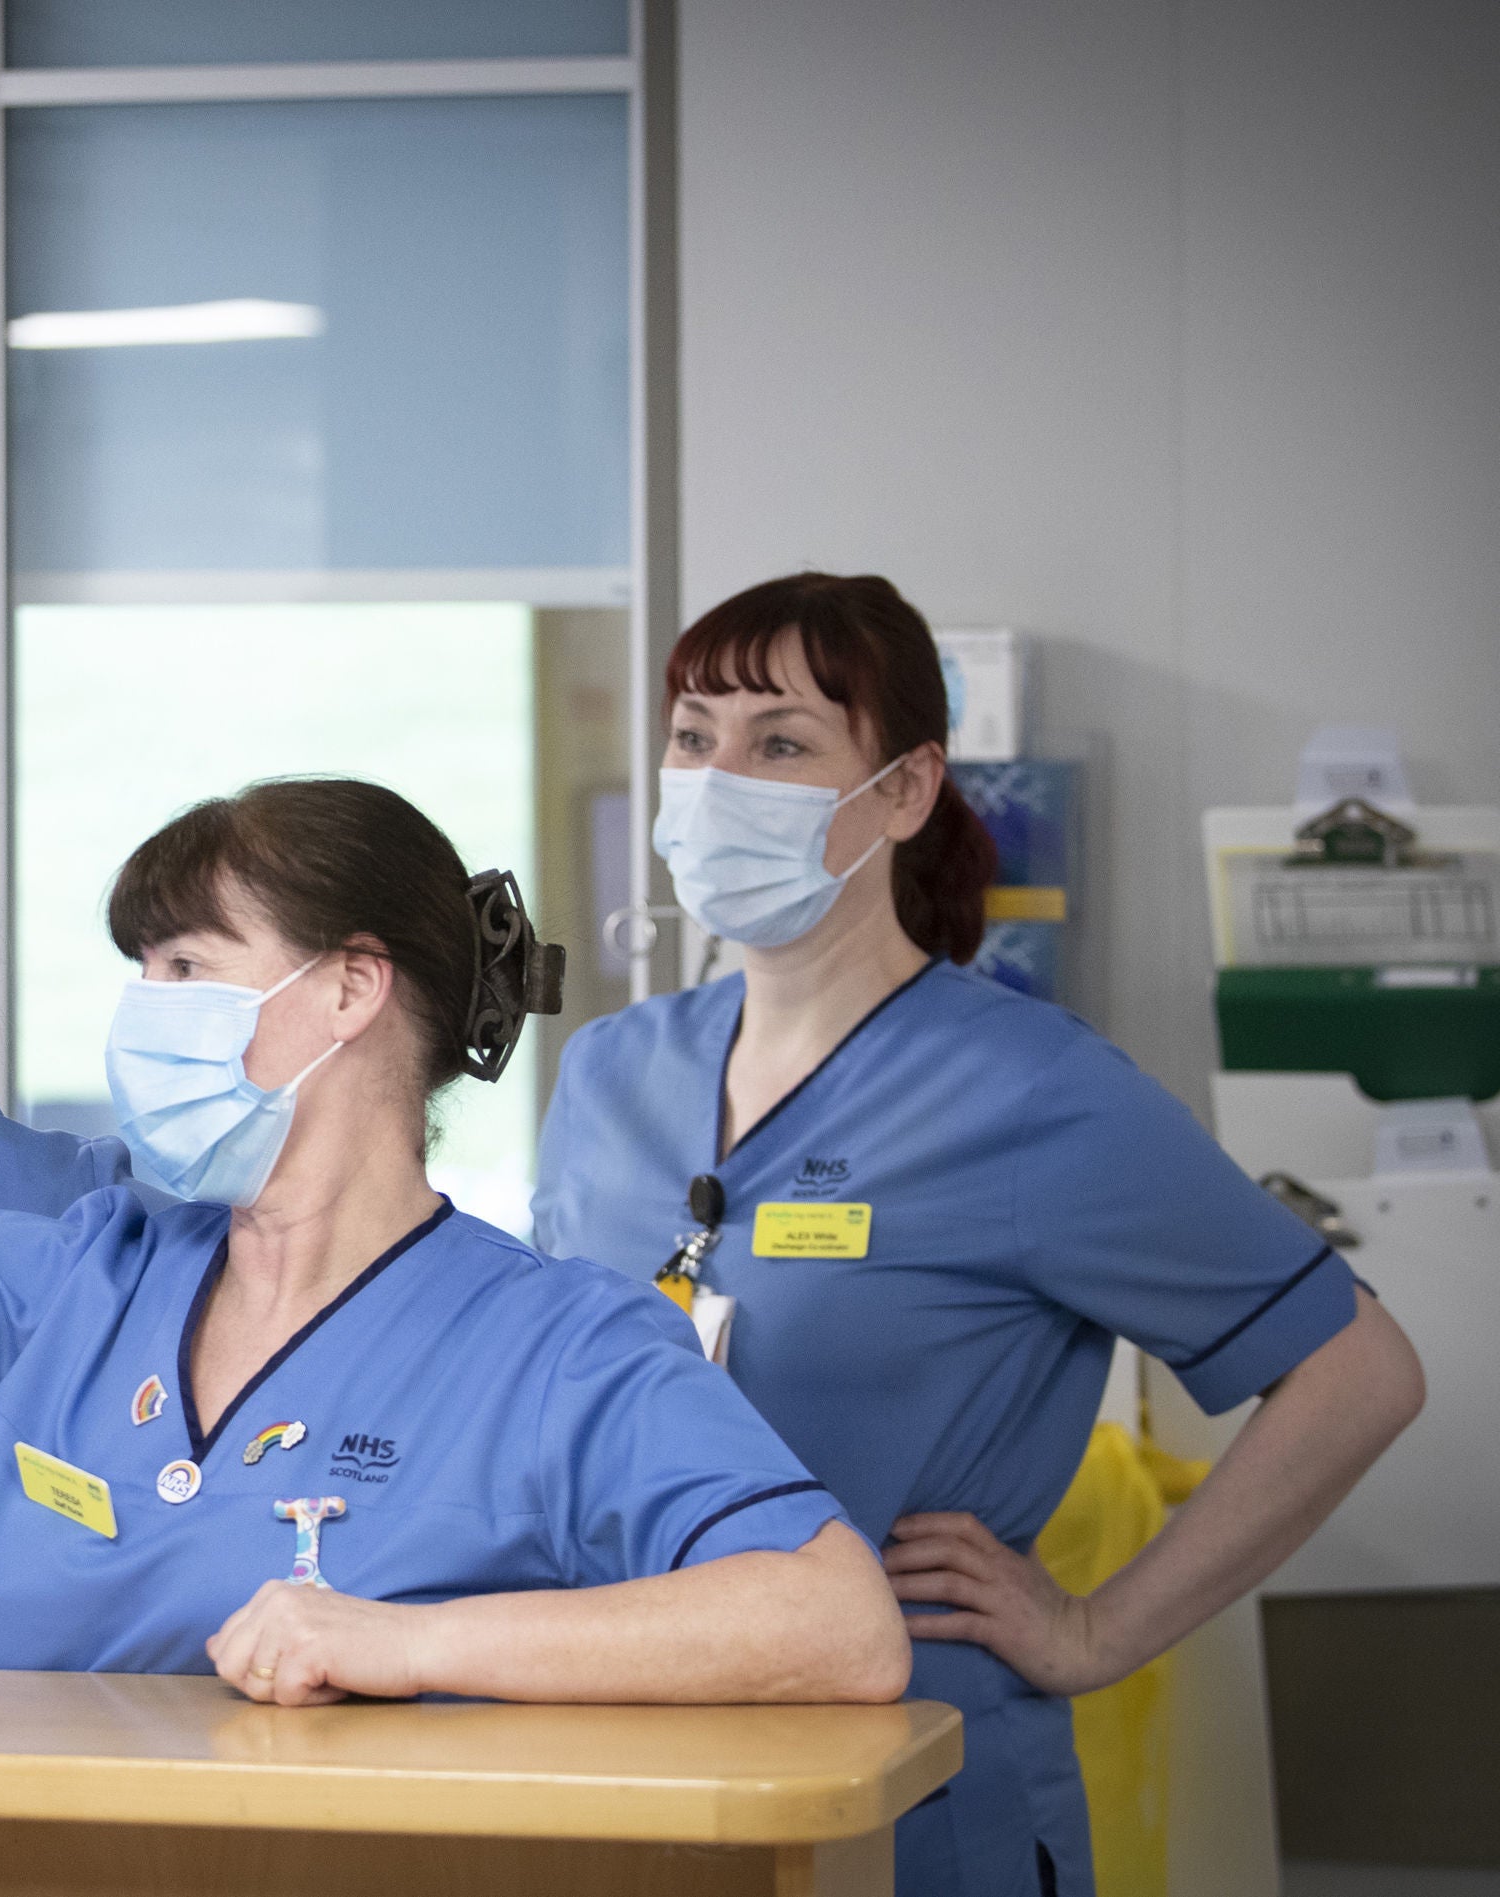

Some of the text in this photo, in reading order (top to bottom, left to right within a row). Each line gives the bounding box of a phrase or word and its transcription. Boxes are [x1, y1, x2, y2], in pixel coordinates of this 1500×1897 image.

[803, 1158, 848, 1176] NHS
[339, 1433, 397, 1460] NHS
[159, 1472, 191, 1498] NHS
[329, 1466, 390, 1484] SCOTLAND
